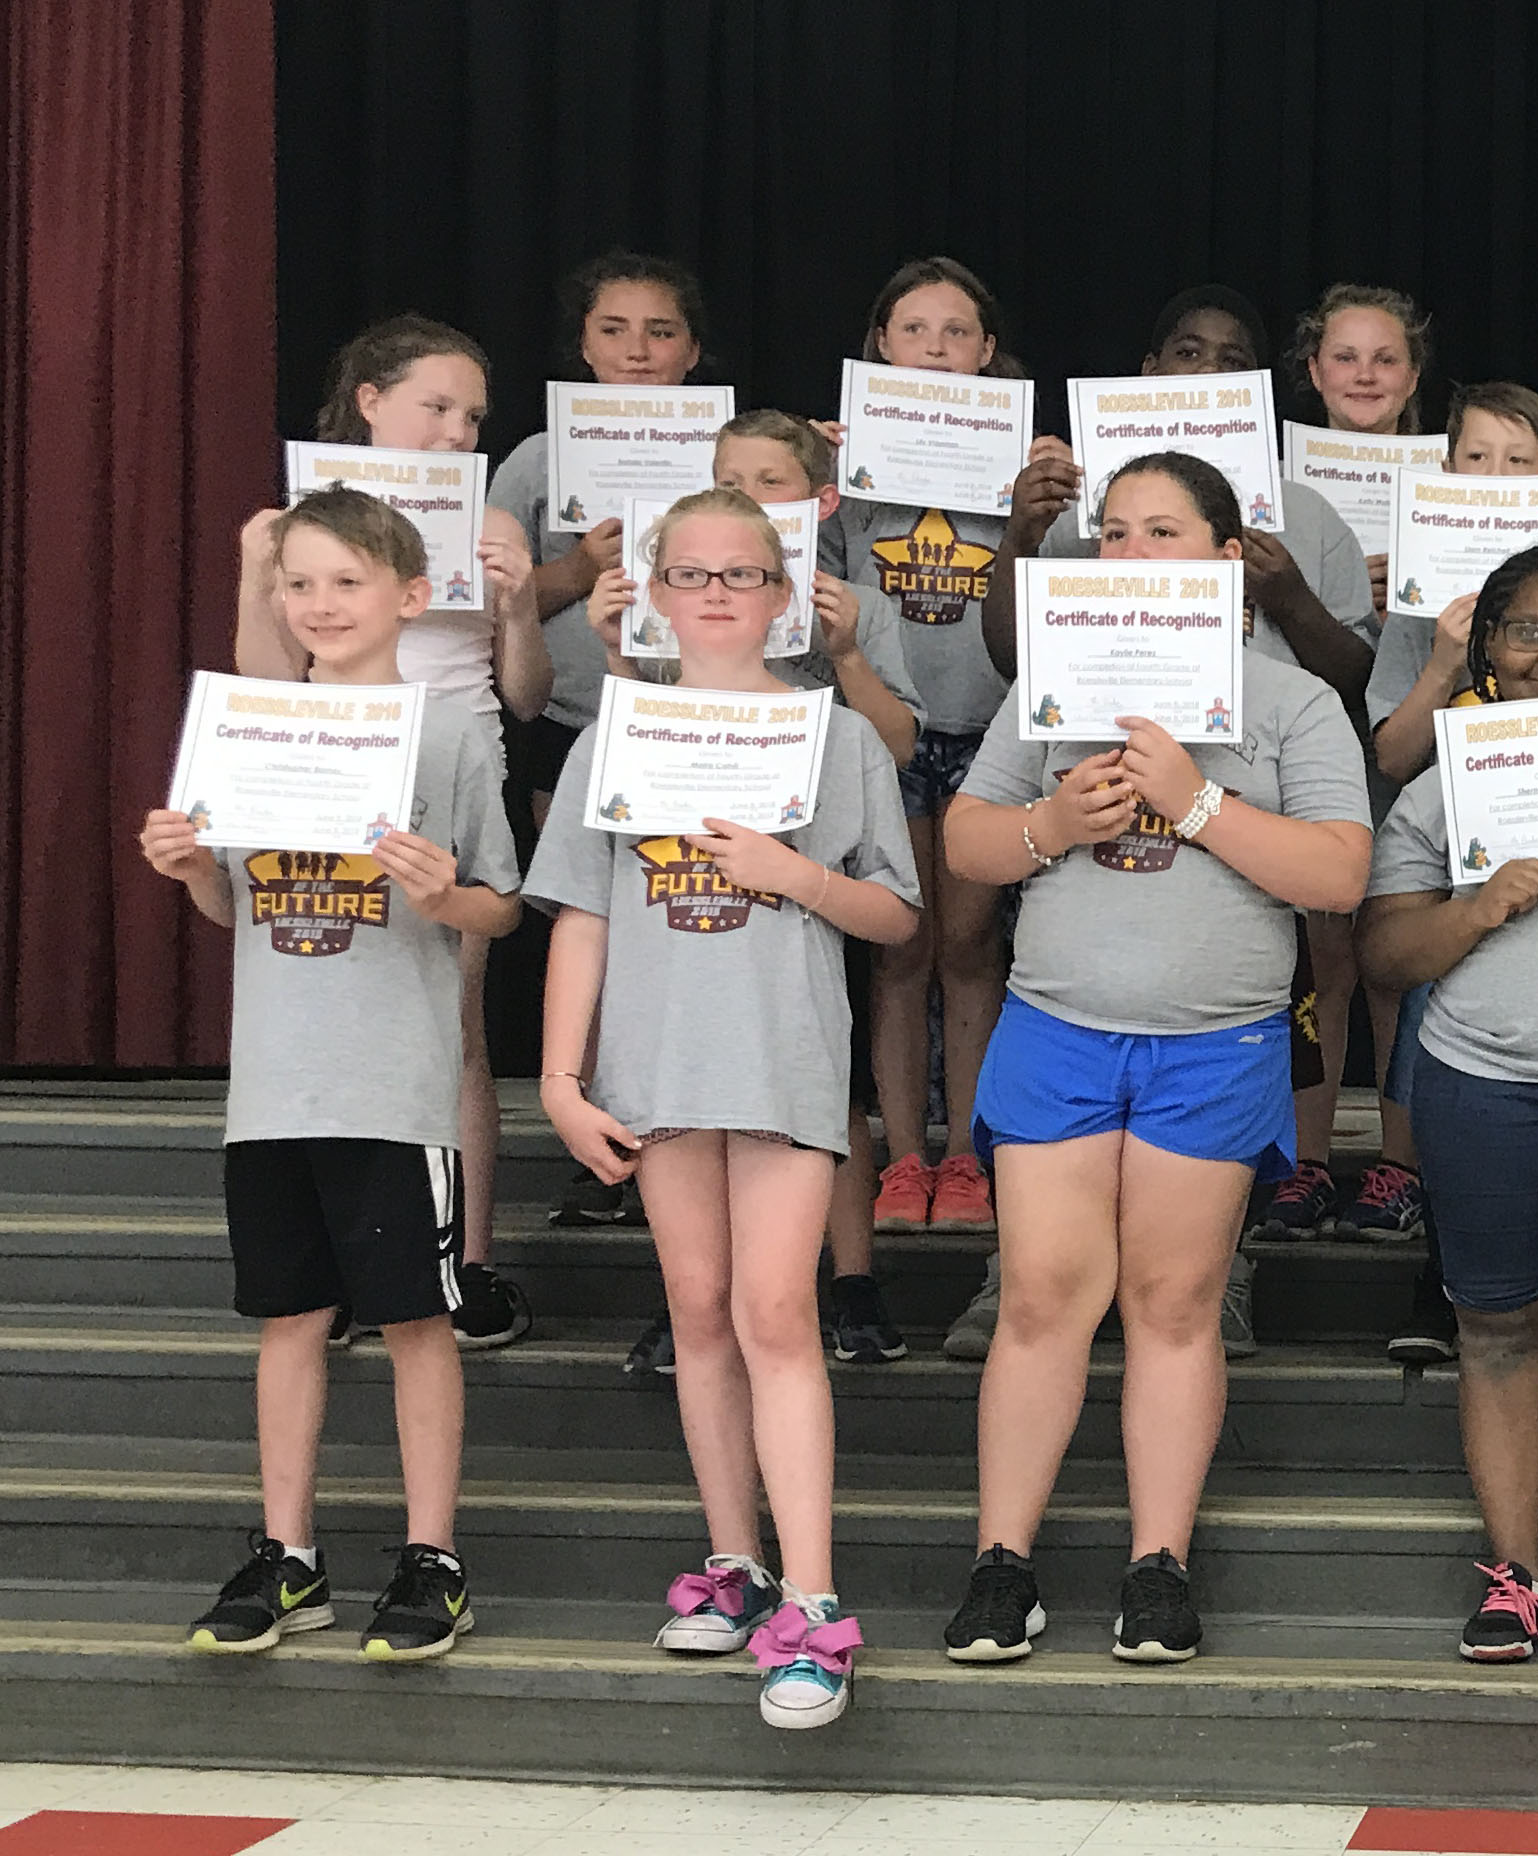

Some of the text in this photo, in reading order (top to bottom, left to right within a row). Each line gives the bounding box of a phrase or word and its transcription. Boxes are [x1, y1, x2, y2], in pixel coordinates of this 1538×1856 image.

[1097, 388, 1252, 413] ROESSLEVILLE 2018
[864, 403, 1012, 432] Certificate of Recognition
[1096, 419, 1256, 438] Certificate of Recognition
[569, 426, 630, 440] Certificate
[634, 429, 645, 441] of
[1305, 464, 1377, 483] Certificate of
[1412, 510, 1474, 528] Certificate
[1479, 517, 1490, 529] of
[885, 570, 988, 597] FUTURE
[1048, 576, 1219, 598] ROESSLEVILLE 2018
[1046, 610, 1222, 631] Certificate of Recognition
[363, 702, 402, 721] 2018
[633, 697, 807, 723] ROESSLEVILLE 2018
[216, 723, 399, 750] Certificate of Recognition
[626, 725, 806, 748] Certificate of Recognition
[1466, 753, 1534, 771] Certificate
[256, 892, 383, 920] FUTURE
